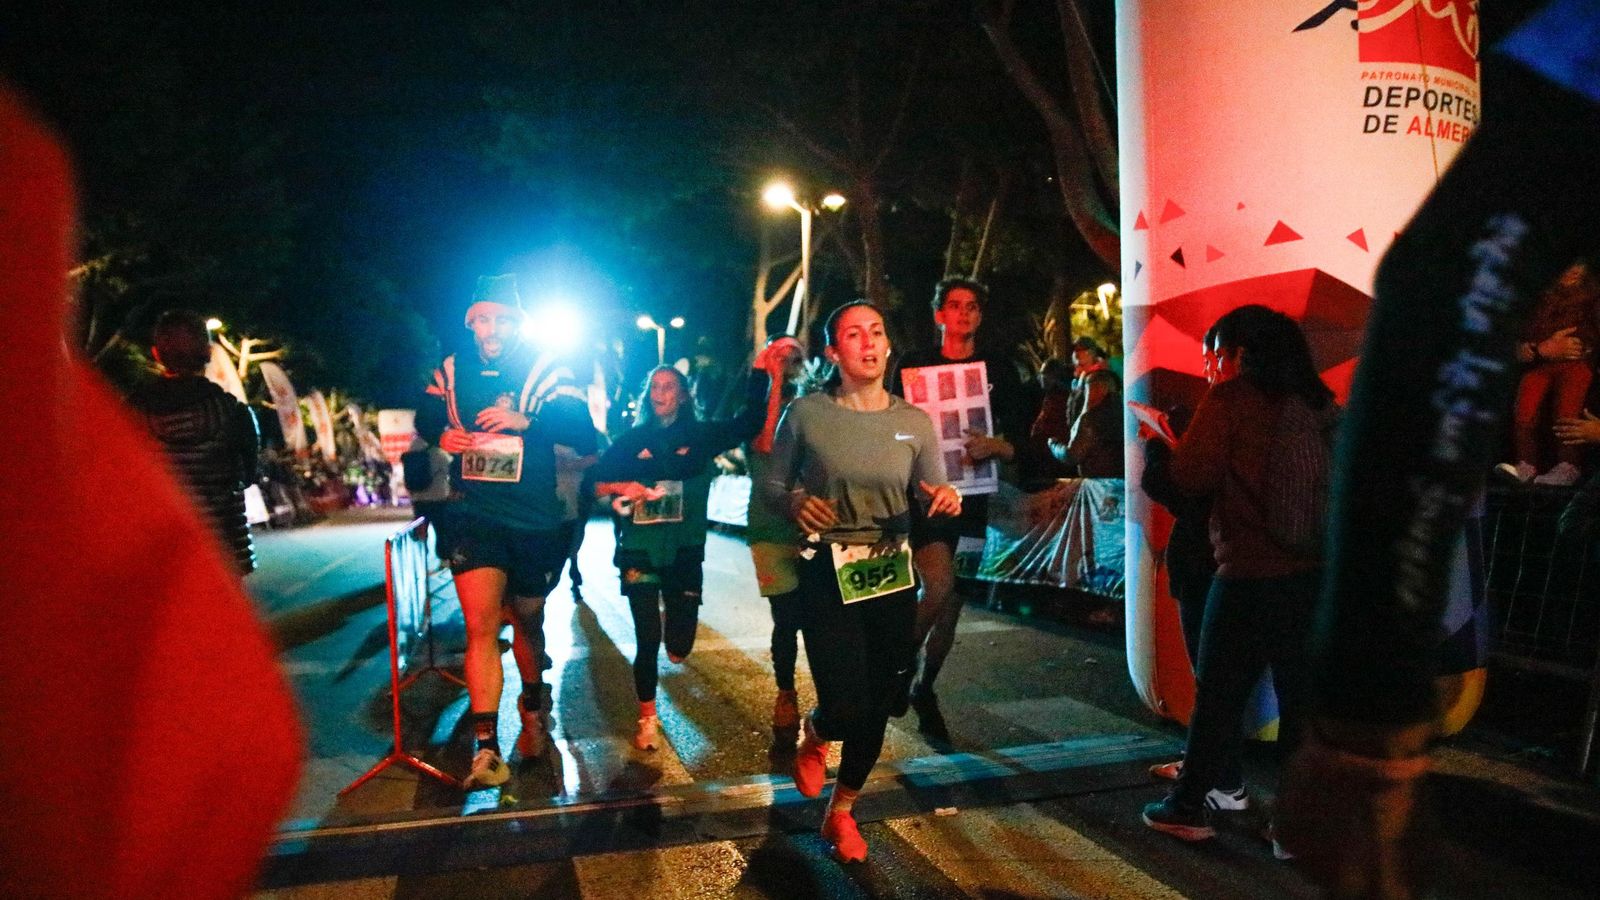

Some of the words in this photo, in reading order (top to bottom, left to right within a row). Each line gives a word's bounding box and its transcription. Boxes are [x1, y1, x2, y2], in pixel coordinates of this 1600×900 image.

[1361, 71, 1429, 83] PATRONATO
[1363, 86, 1478, 124] DEPORTES
[1363, 114, 1399, 134] DE
[466, 456, 514, 475] 1074
